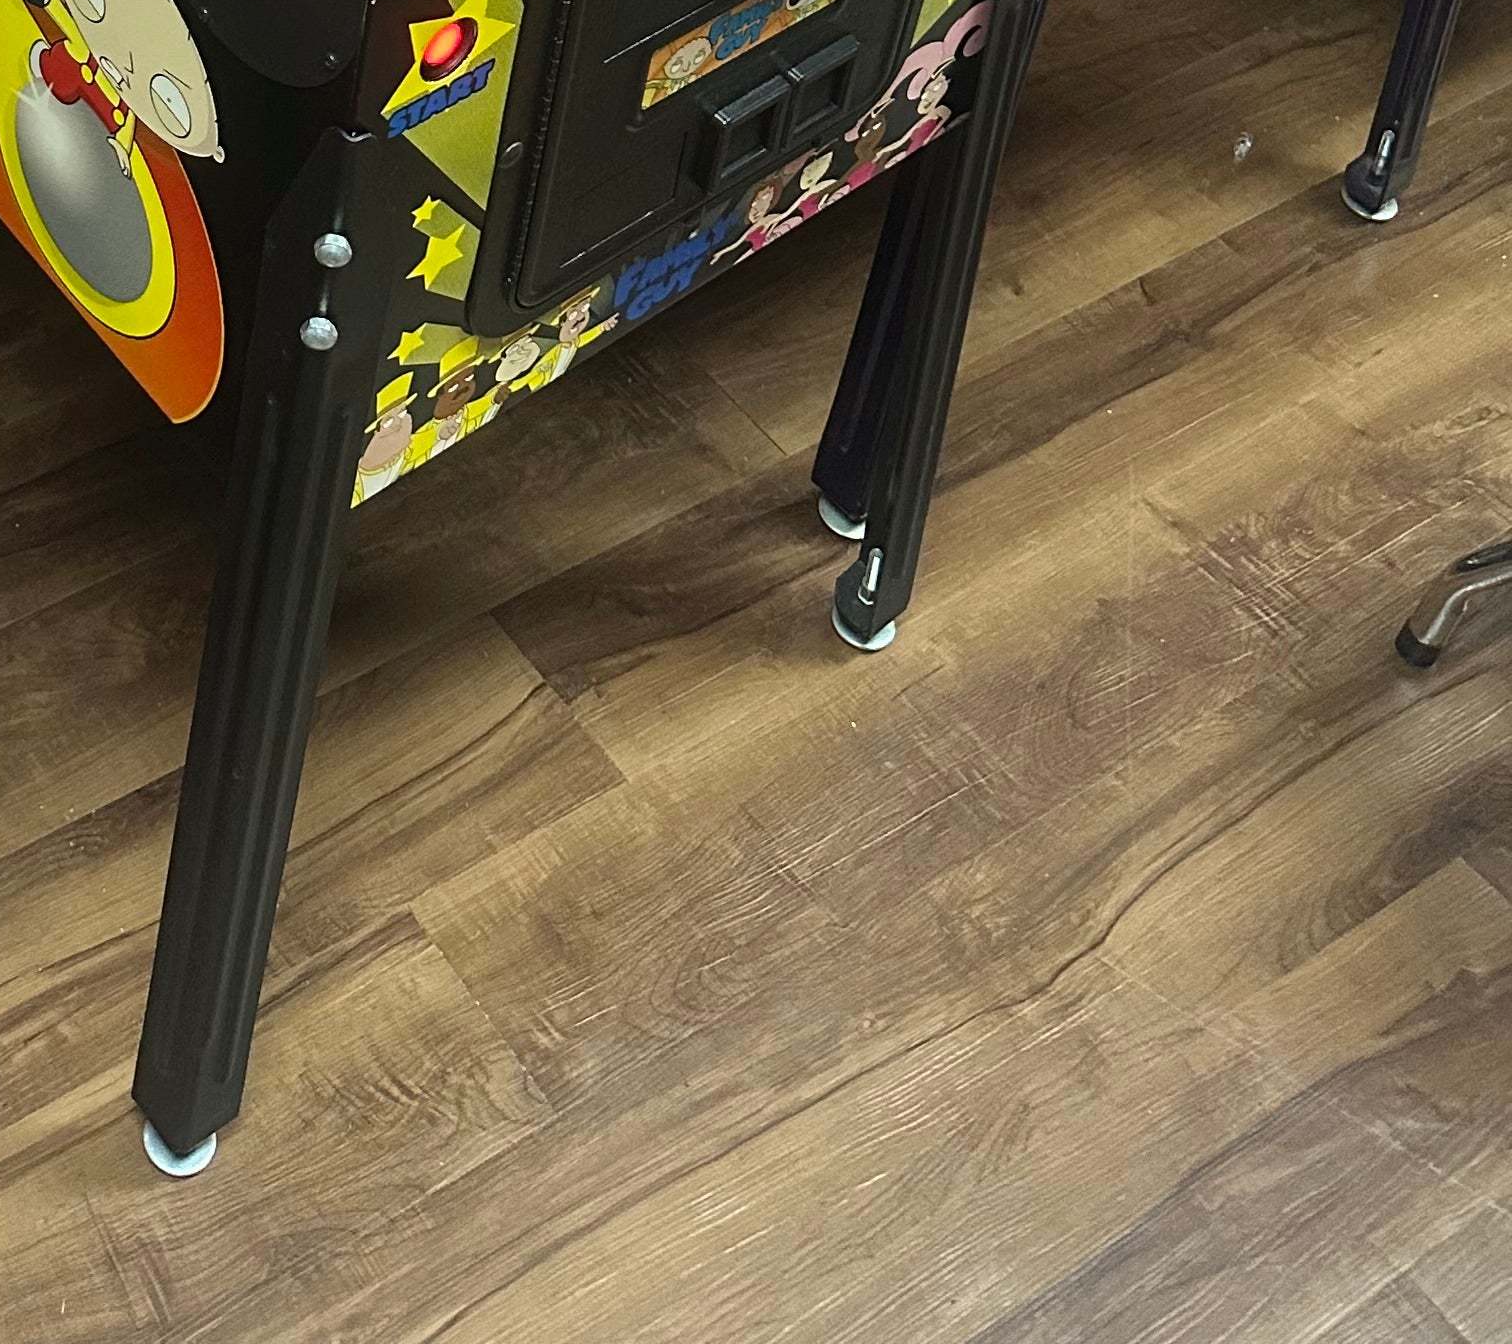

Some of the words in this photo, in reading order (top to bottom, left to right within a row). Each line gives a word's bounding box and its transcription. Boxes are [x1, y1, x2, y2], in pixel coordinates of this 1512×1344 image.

[387, 58, 494, 138] START
[614, 210, 740, 307] FAMILY
[625, 262, 700, 322] GUY
